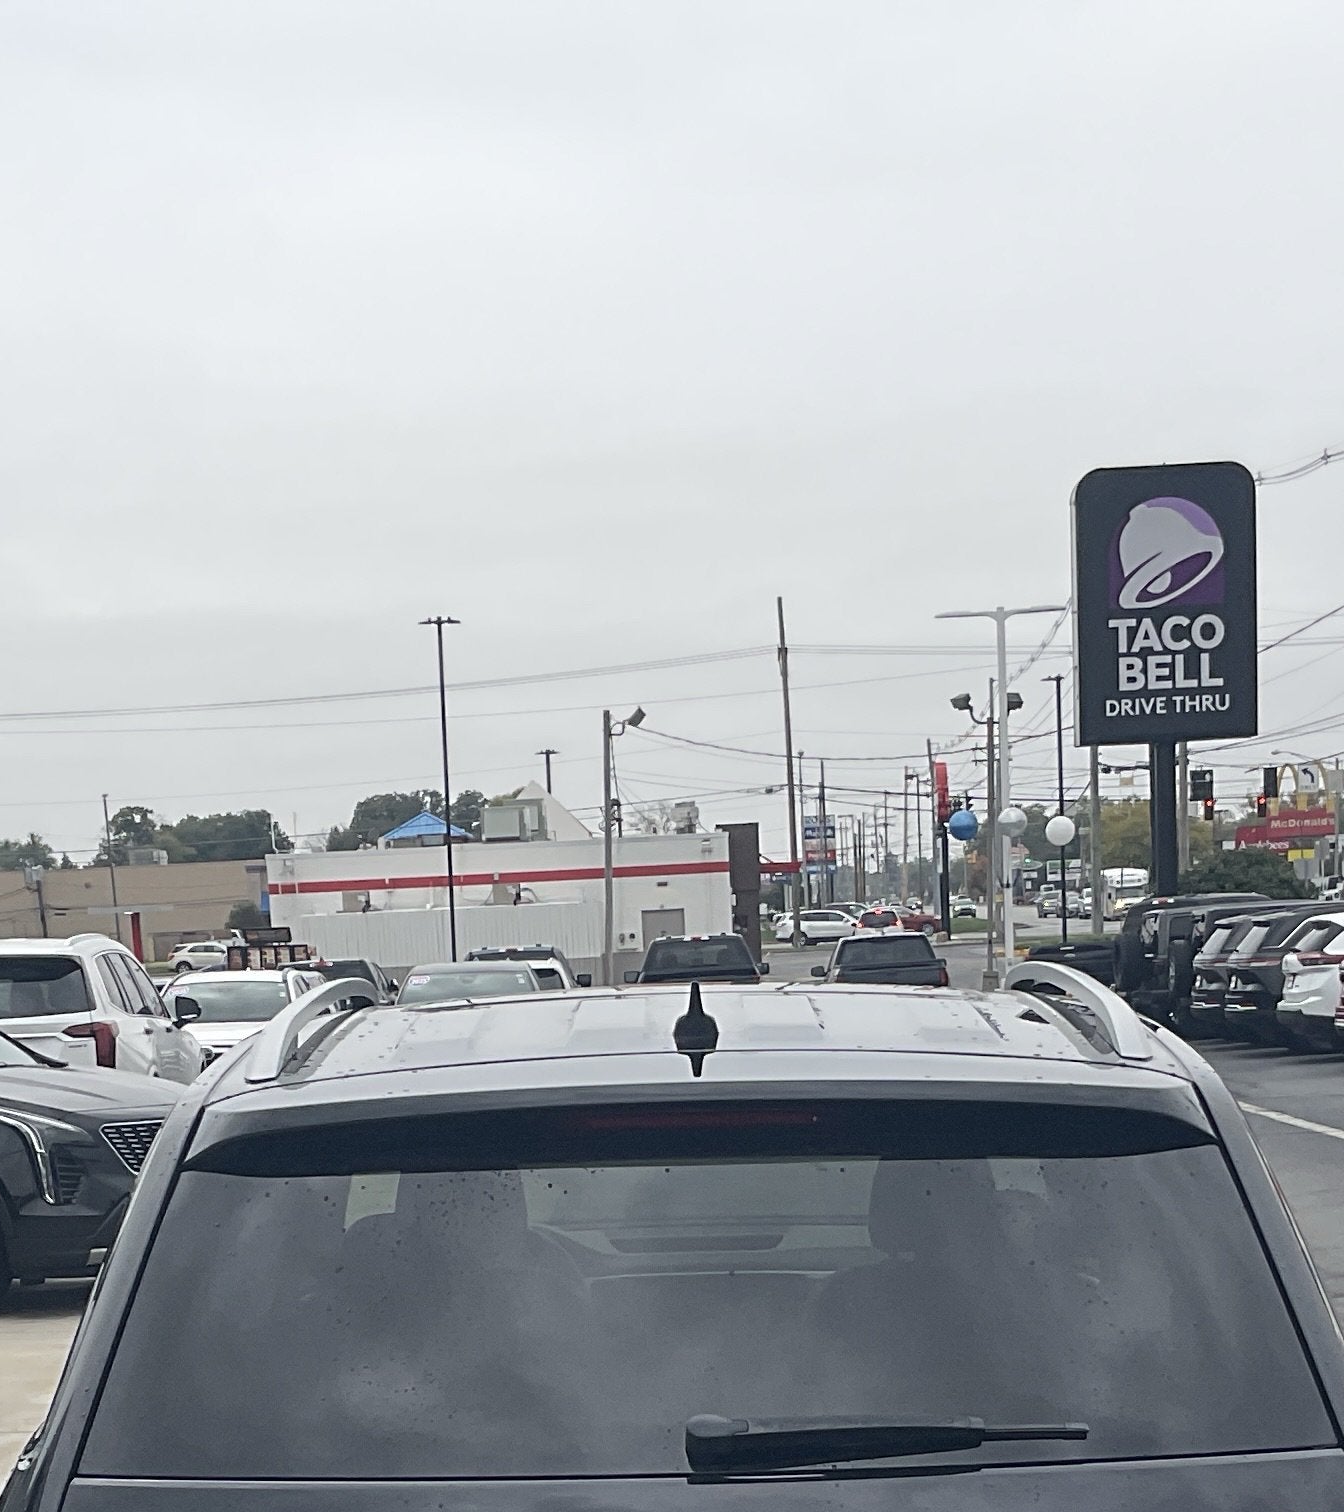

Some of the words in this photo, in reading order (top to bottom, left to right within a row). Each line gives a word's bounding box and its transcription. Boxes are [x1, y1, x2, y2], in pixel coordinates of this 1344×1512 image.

[1108, 614, 1225, 653] TACO
[1118, 653, 1224, 691] BELL
[1105, 697, 1167, 717] DRIVE
[1172, 693, 1230, 713] THRU
